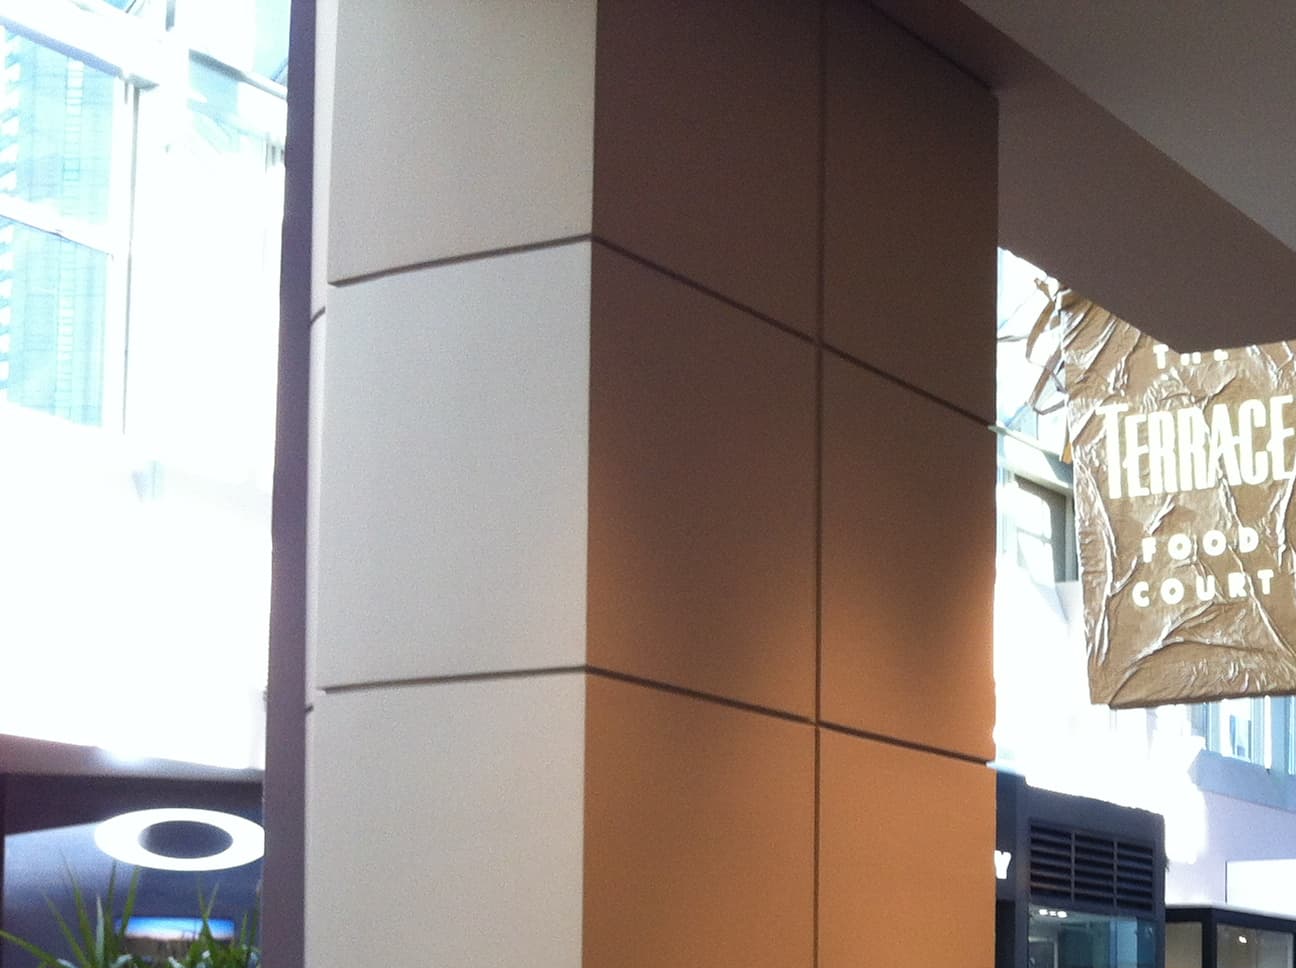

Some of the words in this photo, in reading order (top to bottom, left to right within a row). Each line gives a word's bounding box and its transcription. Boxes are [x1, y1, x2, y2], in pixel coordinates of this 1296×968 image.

[1095, 395, 1295, 499] TERRACE
[1141, 527, 1259, 563] FOOD
[1132, 569, 1274, 607] COURT
